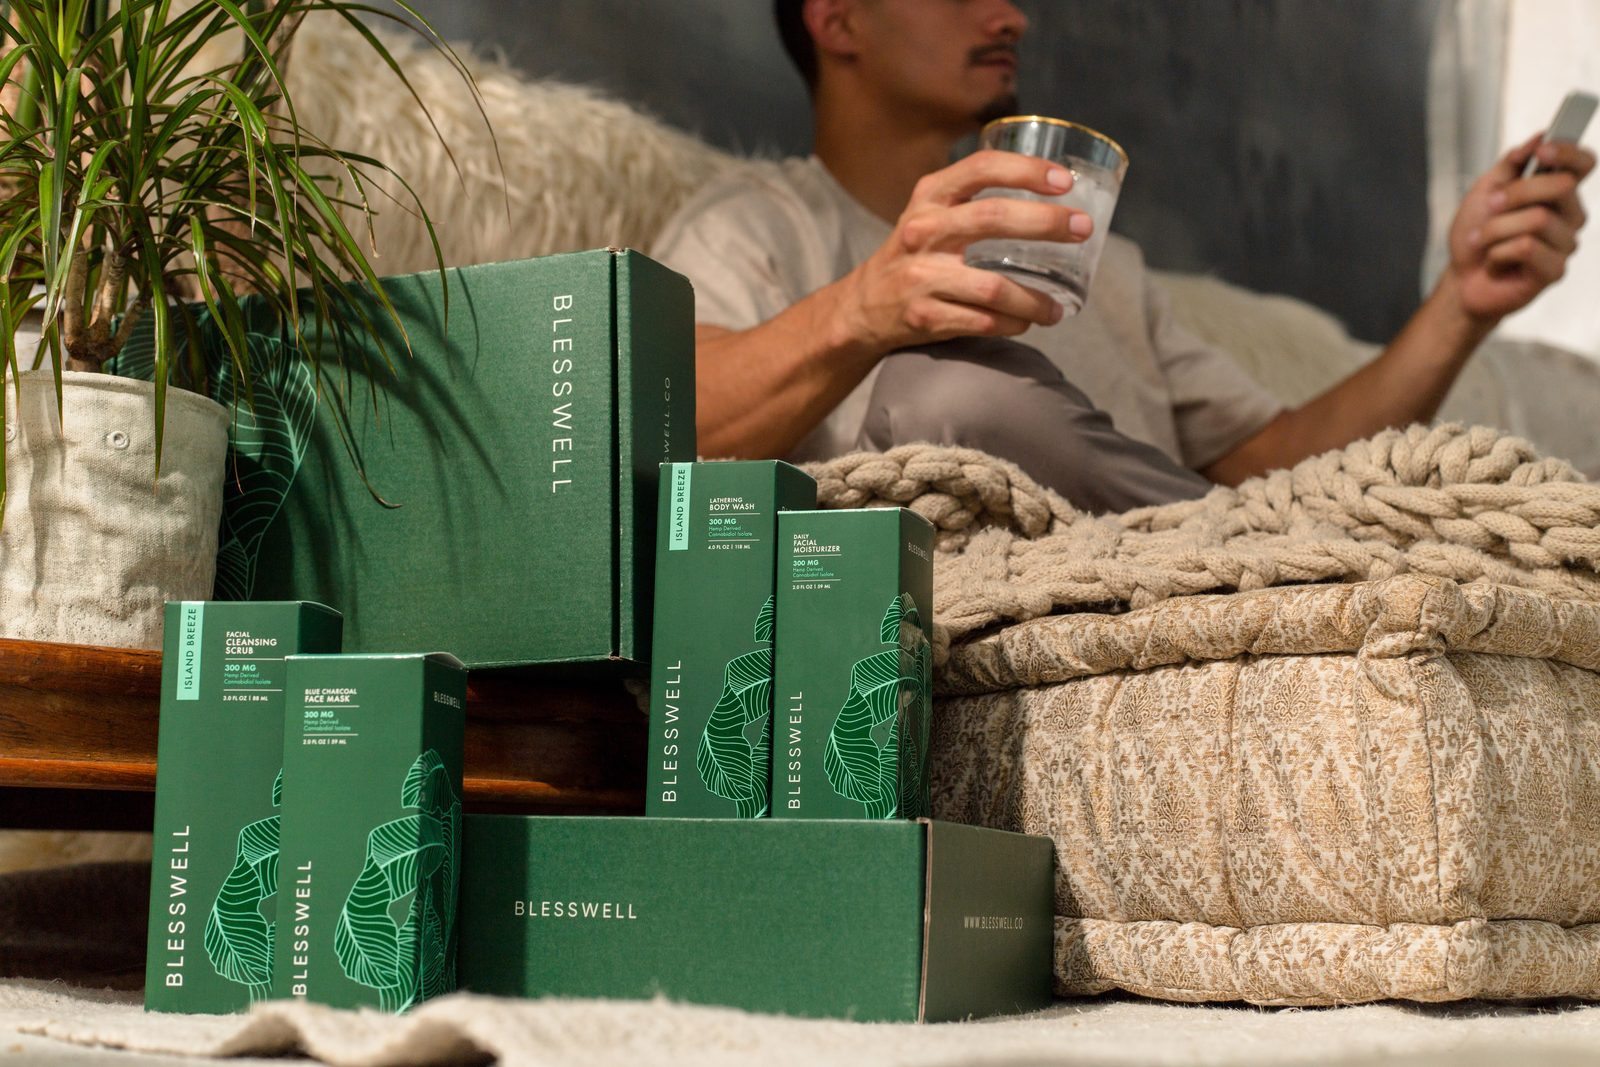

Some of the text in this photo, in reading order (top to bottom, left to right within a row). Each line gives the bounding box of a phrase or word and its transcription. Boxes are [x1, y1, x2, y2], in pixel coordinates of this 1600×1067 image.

[553, 294, 573, 494] BLESSWELL
[676, 469, 686, 541] ISLAND BREEZE
[793, 545, 841, 553] MOISTURIZER
[184, 608, 197, 690] ISLAND BREEZE
[225, 638, 278, 647] CLEANSING
[225, 646, 254, 655] SCRUB
[224, 664, 257, 672] 300 MG
[304, 695, 350, 703] FACE MASK
[662, 659, 681, 802] BLESSWELL
[788, 691, 803, 809] BLESSWELL
[165, 825, 190, 987] BLESSWELL
[292, 860, 312, 996] BLESSWELL
[514, 900, 637, 919] BLESSWELL
[963, 915, 1024, 930] WWW.BLESSWELL.CO
